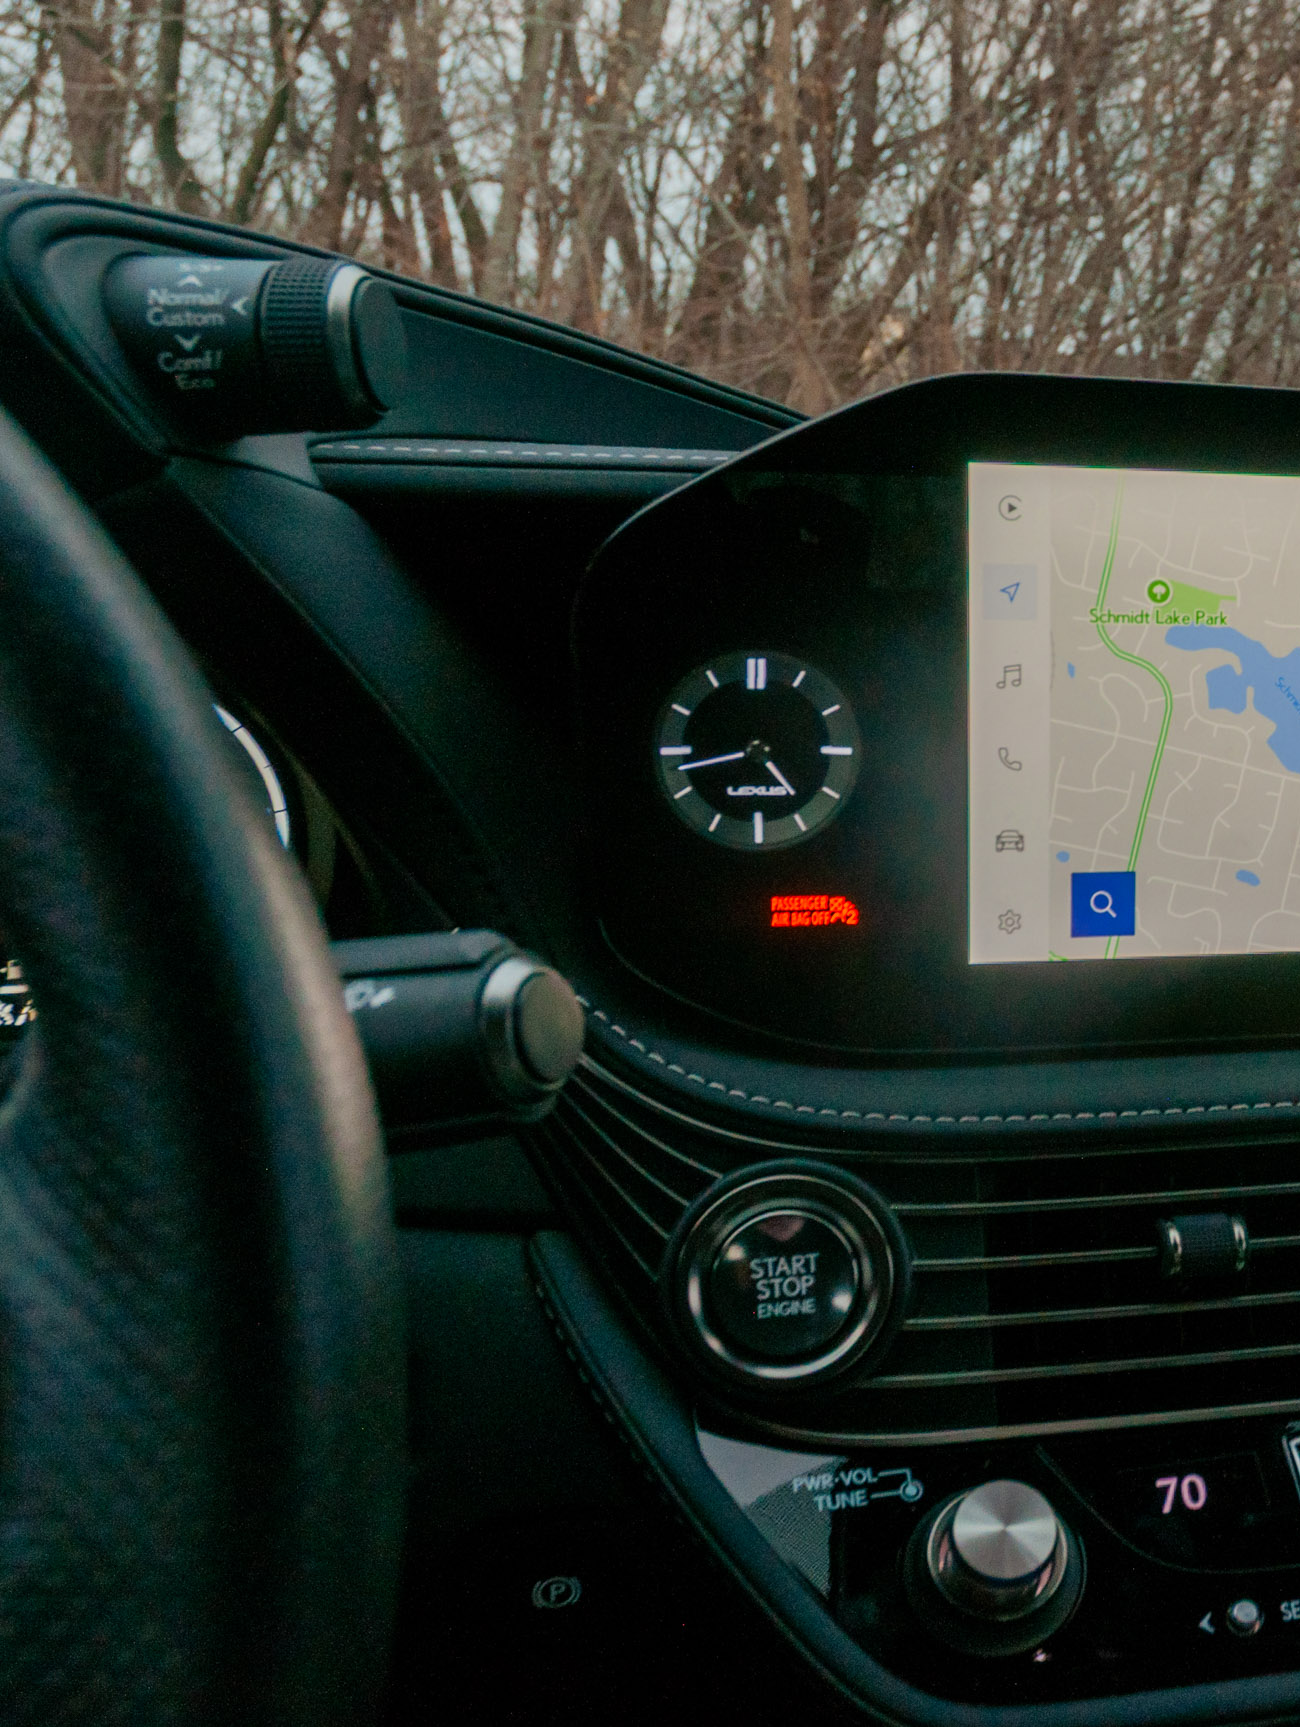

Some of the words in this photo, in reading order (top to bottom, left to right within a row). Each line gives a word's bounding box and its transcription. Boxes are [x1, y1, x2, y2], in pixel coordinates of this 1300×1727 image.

[145, 306, 224, 326] Custom
[1089, 608, 1150, 626] Schmidt
[1155, 610, 1191, 626] Lake
[1195, 610, 1228, 627] Park
[727, 785, 787, 796] LEXUS
[771, 895, 829, 912] PASSENGER
[771, 911, 791, 927] AIR
[791, 911, 812, 927] BAG
[811, 910, 830, 926] OFF
[750, 1252, 819, 1279] START
[756, 1275, 816, 1300] STOP
[757, 1299, 816, 1319] ENGINE
[814, 1488, 868, 1512] TUNE
[1155, 1474, 1208, 1514] 70
